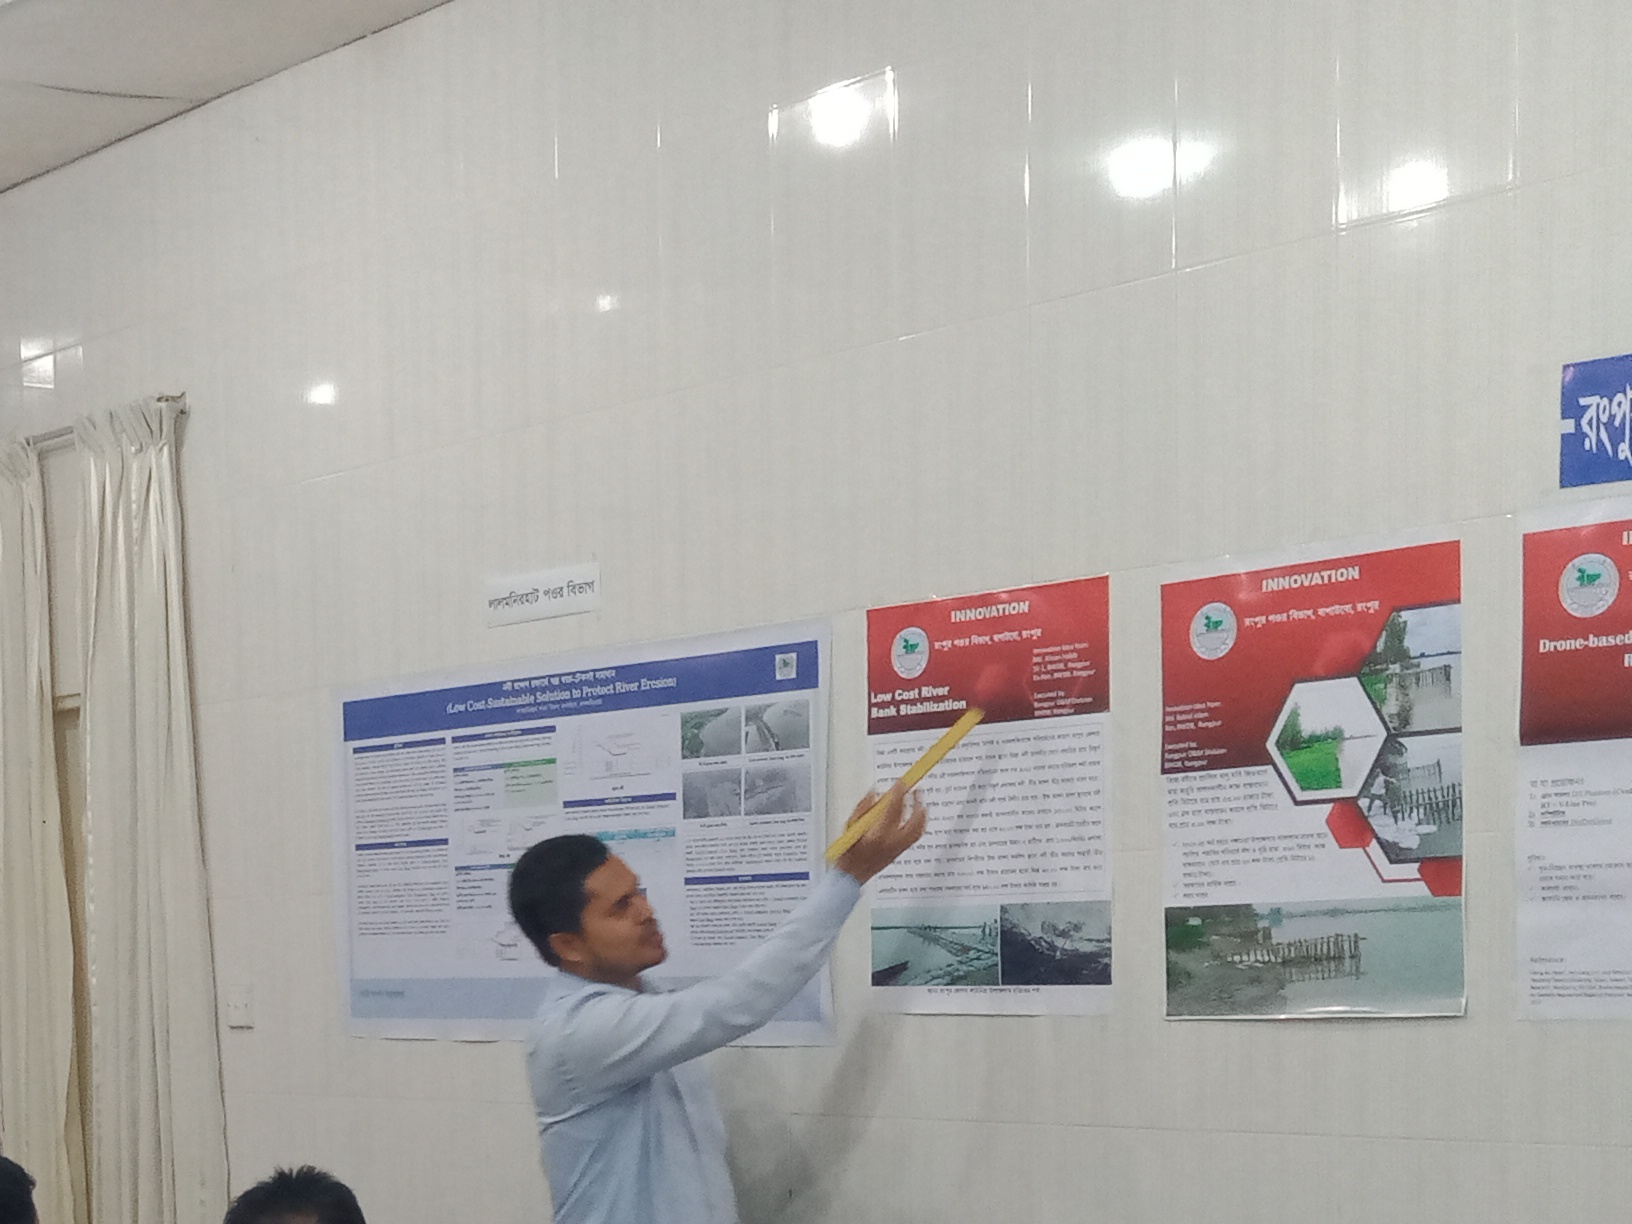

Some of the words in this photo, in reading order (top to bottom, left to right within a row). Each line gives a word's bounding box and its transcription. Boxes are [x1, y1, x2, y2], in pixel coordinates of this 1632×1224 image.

[567, 580, 596, 597] বিভাগ
[1261, 565, 1361, 593] INNOVATION
[951, 600, 1030, 623] INNOVATION
[870, 691, 894, 704] Low
[895, 688, 920, 701] Cost
[921, 685, 950, 699] River
[870, 705, 898, 719] Bank
[899, 698, 967, 717] Stabilization
